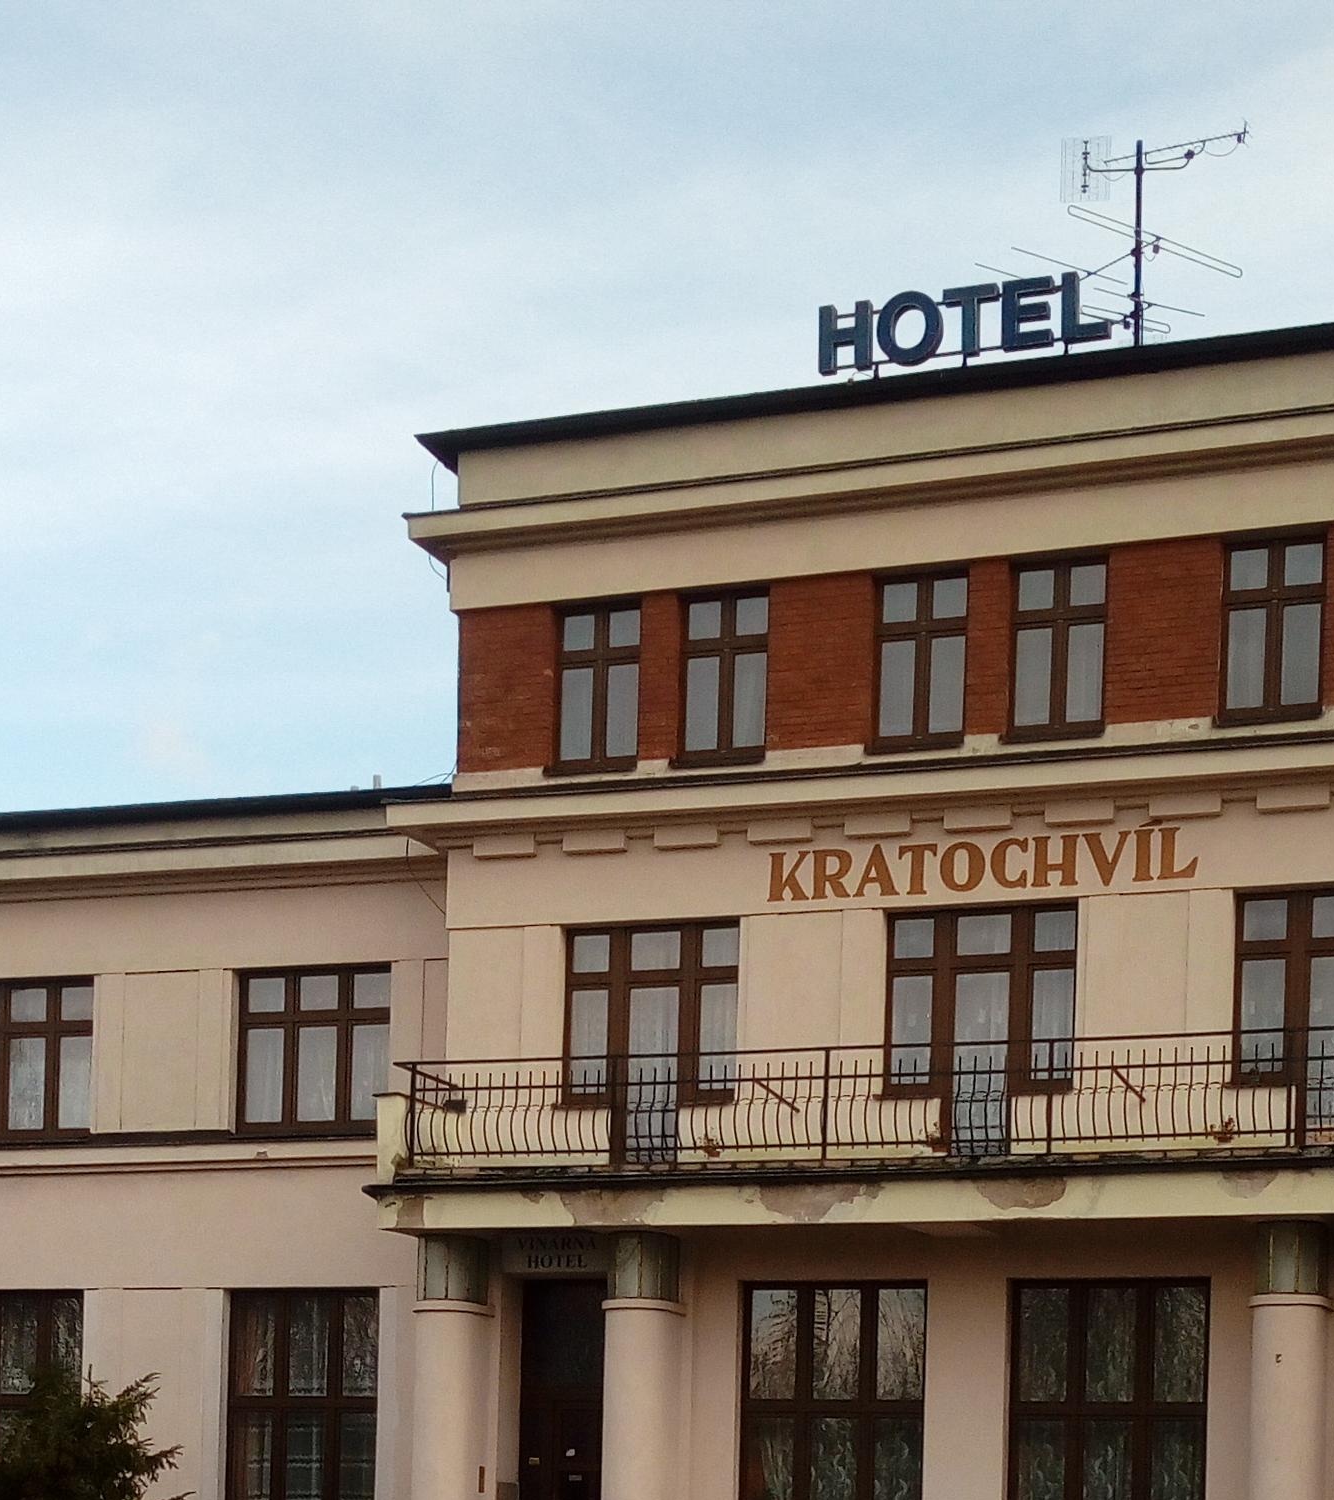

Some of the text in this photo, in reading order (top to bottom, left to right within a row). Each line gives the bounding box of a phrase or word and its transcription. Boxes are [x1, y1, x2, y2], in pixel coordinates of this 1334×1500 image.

[818, 271, 1112, 376] HOTEL
[767, 819, 1199, 902] KRATOCHVÍL
[526, 1254, 588, 1269] HOTEL
